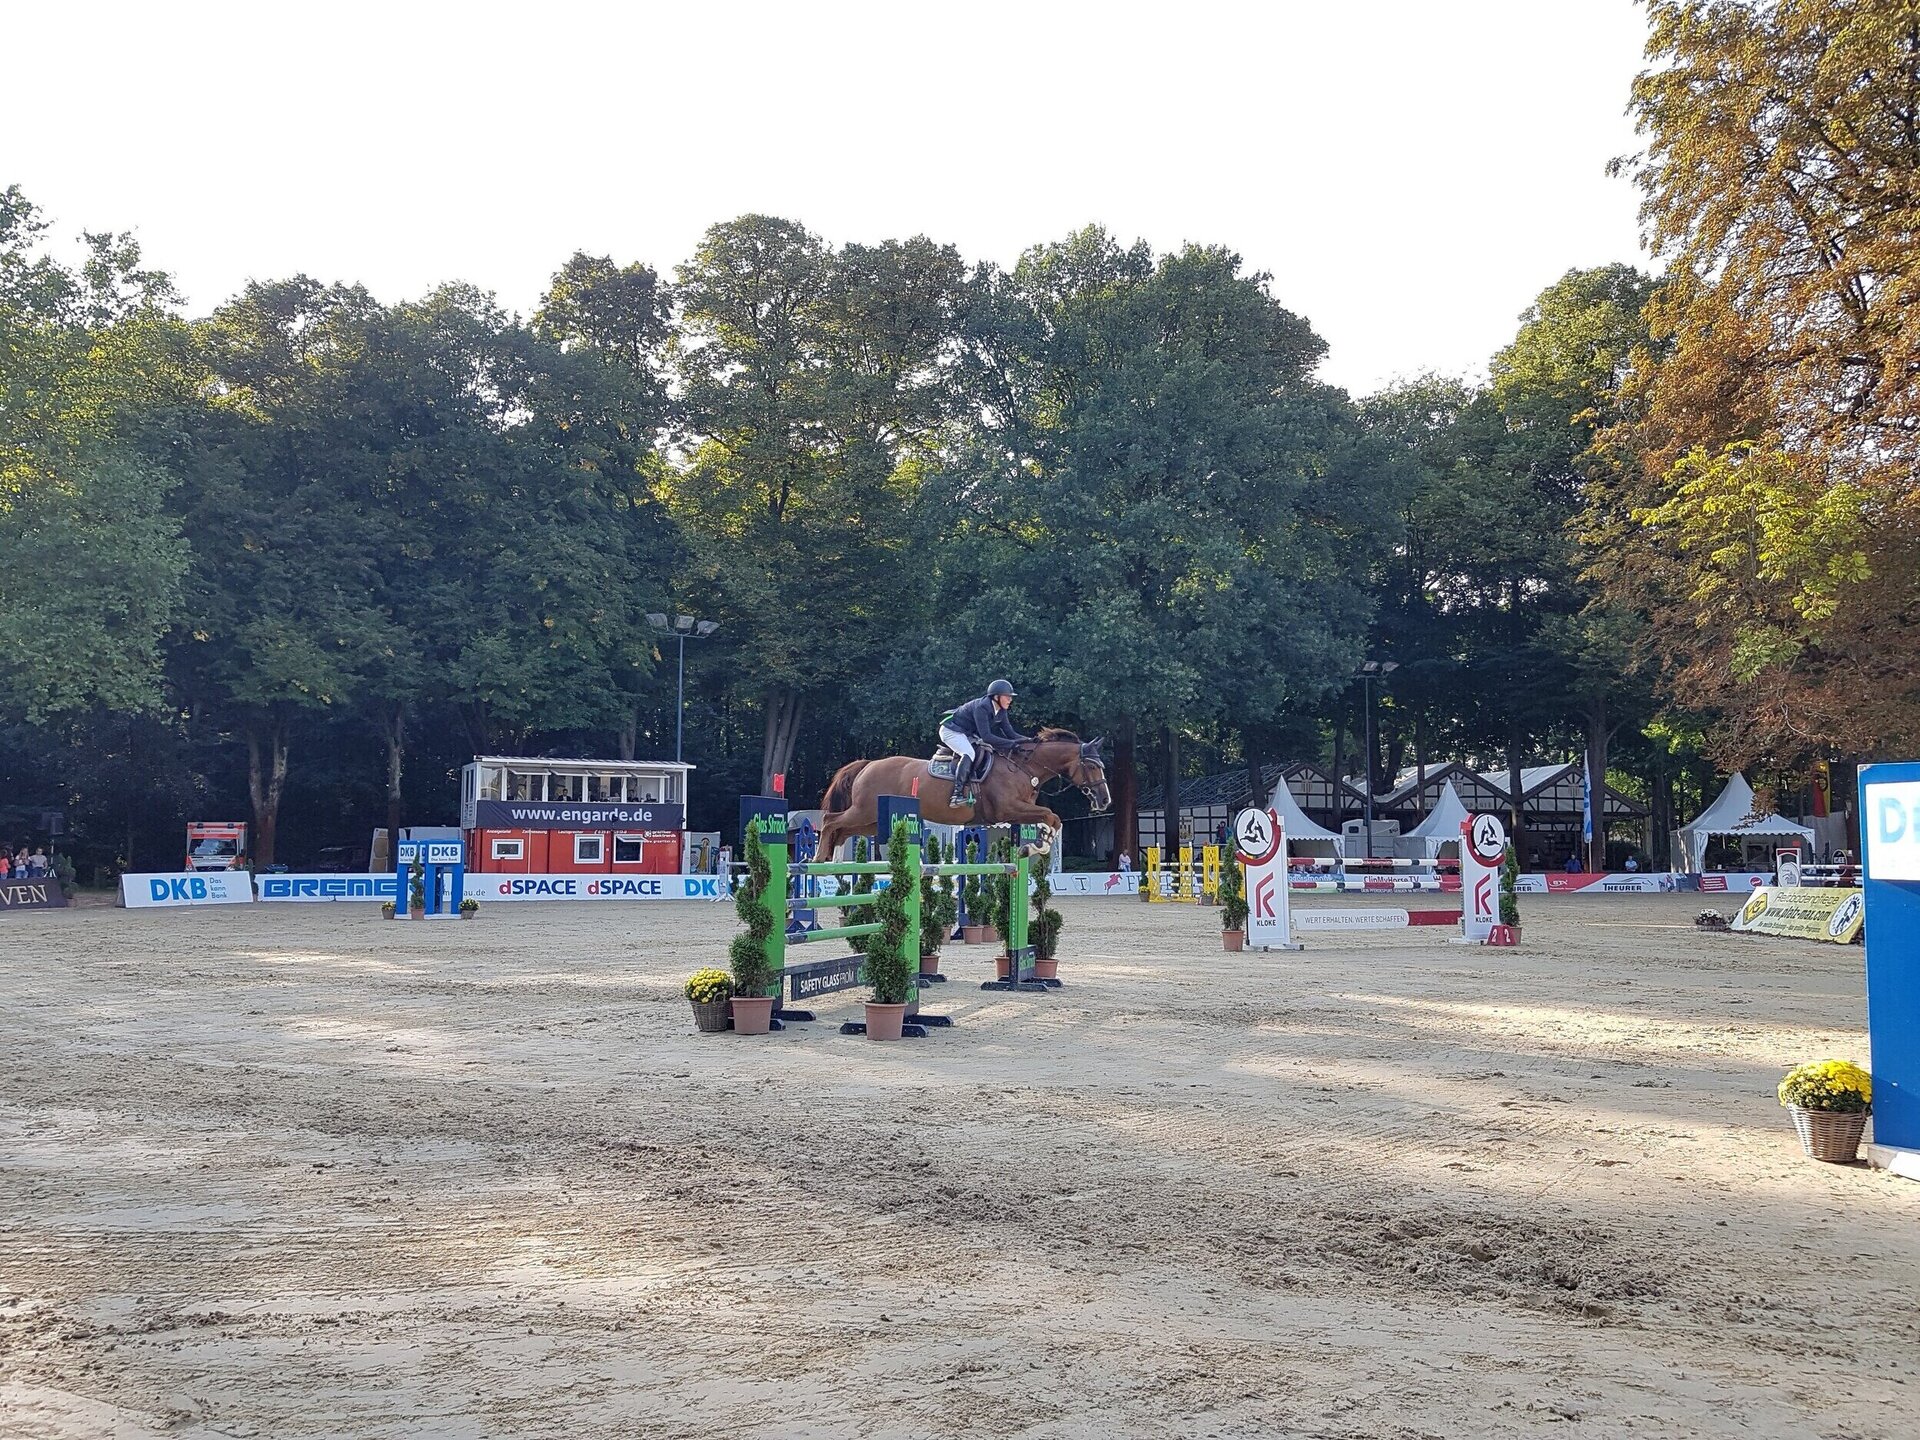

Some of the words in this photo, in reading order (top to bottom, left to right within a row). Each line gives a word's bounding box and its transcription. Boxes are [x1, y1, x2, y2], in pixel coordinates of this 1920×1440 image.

[511, 808, 653, 824] www.engarde.de
[400, 847, 414, 857] DKB
[431, 846, 458, 857] DKB
[150, 878, 208, 901] DKB
[264, 879, 417, 897] BREME
[499, 879, 577, 895] dSPACE
[587, 879, 662, 895] dSPACE
[1602, 882, 1642, 891] THEURER
[211, 891, 228, 899] Bank
[1256, 919, 1276, 927] KLOKE
[1491, 929, 1497, 943] 2
[1504, 929, 1511, 943] 2
[800, 976, 822, 993] SAFETY
[821, 973, 840, 988] GLASS
[840, 970, 854, 985] FROM
